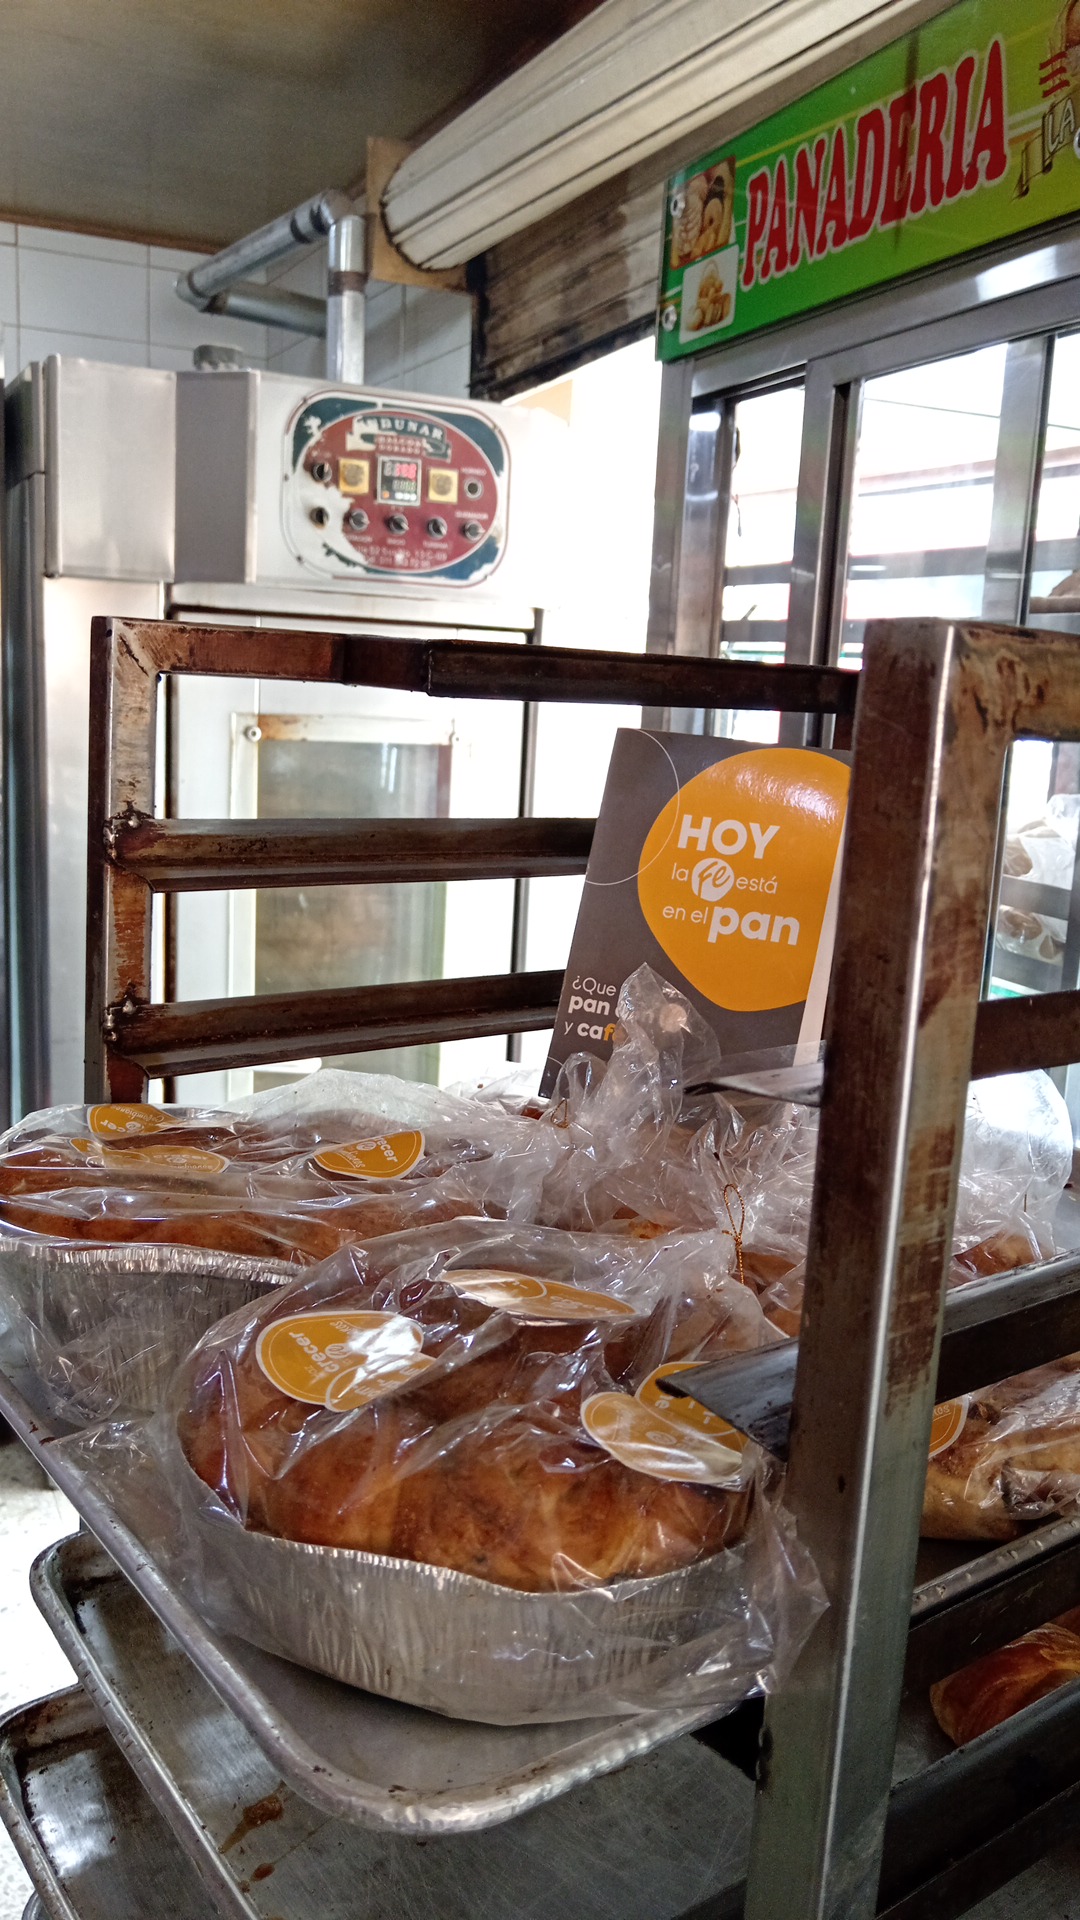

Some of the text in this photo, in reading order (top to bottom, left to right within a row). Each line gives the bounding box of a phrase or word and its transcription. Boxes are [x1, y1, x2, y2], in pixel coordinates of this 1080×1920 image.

[741, 36, 1008, 288] PANADERIA
[677, 814, 780, 859] HOY
[671, 859, 778, 900] la fe está
[662, 904, 800, 946] en el pan
[568, 995, 611, 1016] pan
[572, 975, 617, 996] ¿Que
[564, 1021, 574, 1036] y
[288, 1331, 340, 1373] crecer
